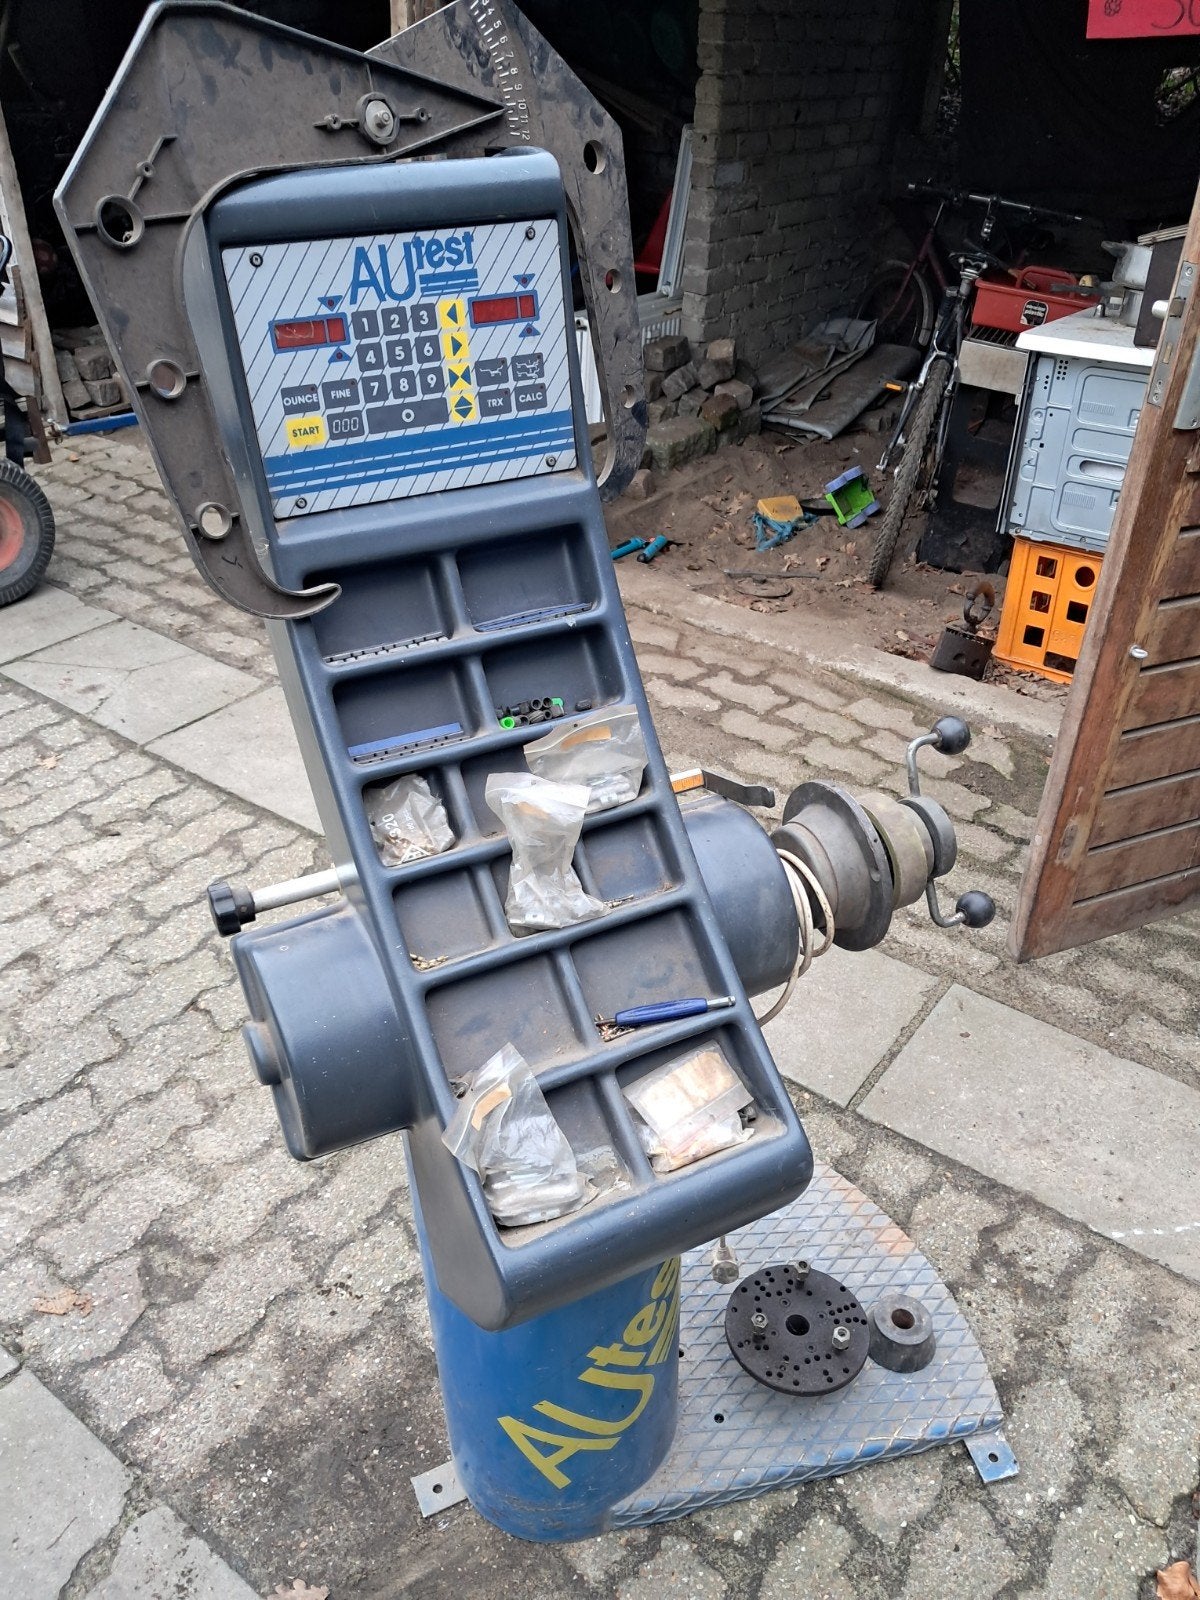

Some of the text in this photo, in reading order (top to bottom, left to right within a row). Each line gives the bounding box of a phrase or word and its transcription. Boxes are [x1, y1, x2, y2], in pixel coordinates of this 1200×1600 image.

[493, 20, 502, 29] 5
[499, 35, 508, 44] 6
[510, 67, 518, 75] 8
[514, 83, 523, 91] 9
[517, 98, 527, 110] 10
[519, 114, 529, 123] 11
[521, 130, 531, 140] 12
[350, 231, 475, 305] AUtest
[361, 310, 429, 332] 1 2 3
[365, 342, 434, 364] 4 5 6
[369, 373, 437, 396] 7 8 9
[283, 393, 319, 406] OUNCE
[330, 388, 351, 400] FINE
[518, 392, 543, 403] CALC
[486, 397, 504, 408] TRX
[292, 425, 320, 438] START
